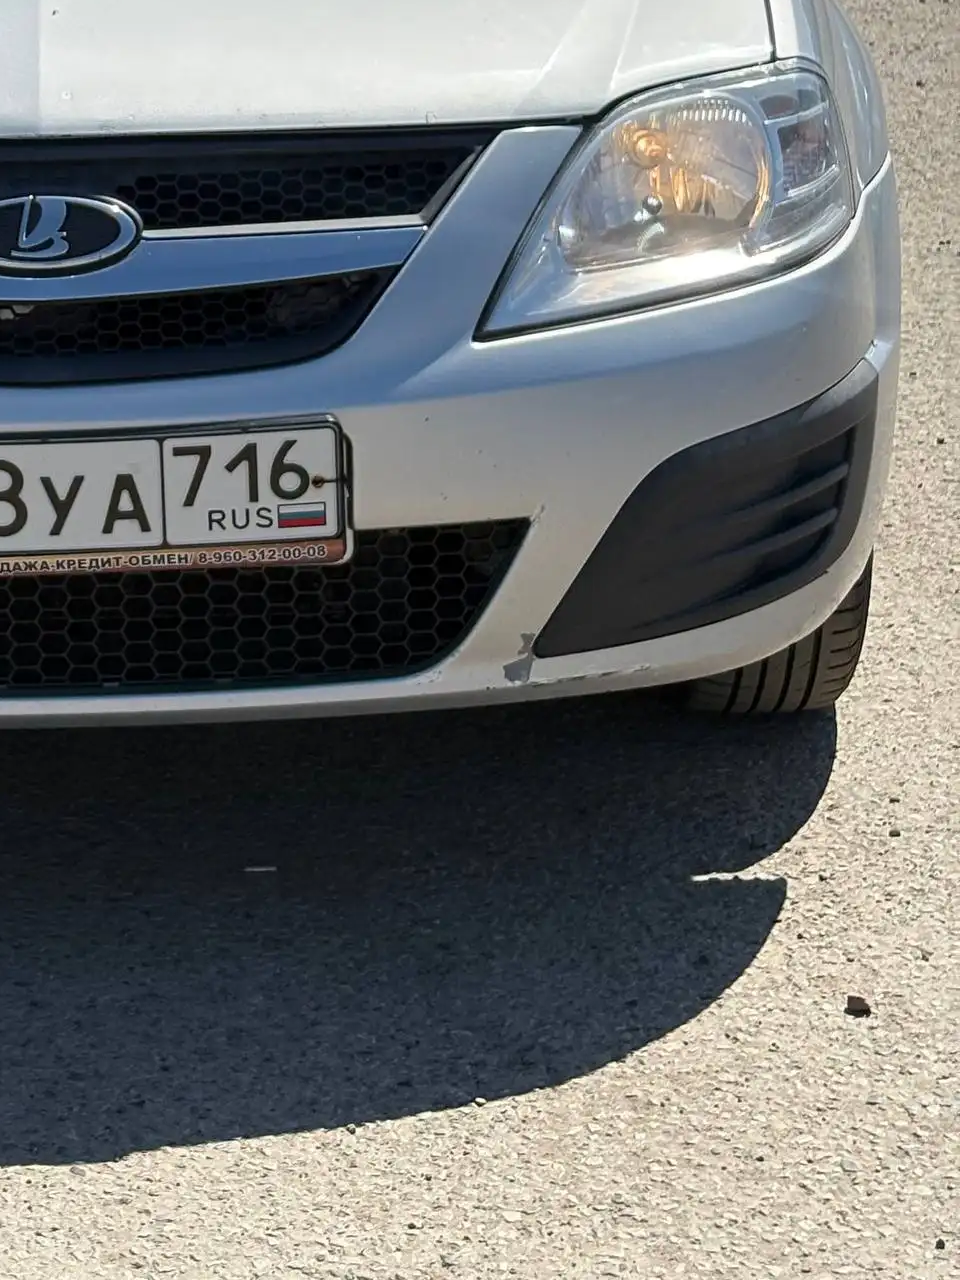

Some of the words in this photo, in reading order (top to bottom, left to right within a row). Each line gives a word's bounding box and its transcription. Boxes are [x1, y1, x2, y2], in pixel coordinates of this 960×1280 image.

[172, 439, 310, 507] 716
[208, 507, 274, 531] RUS
[198, 545, 327, 564] 8-960-312-00-08
